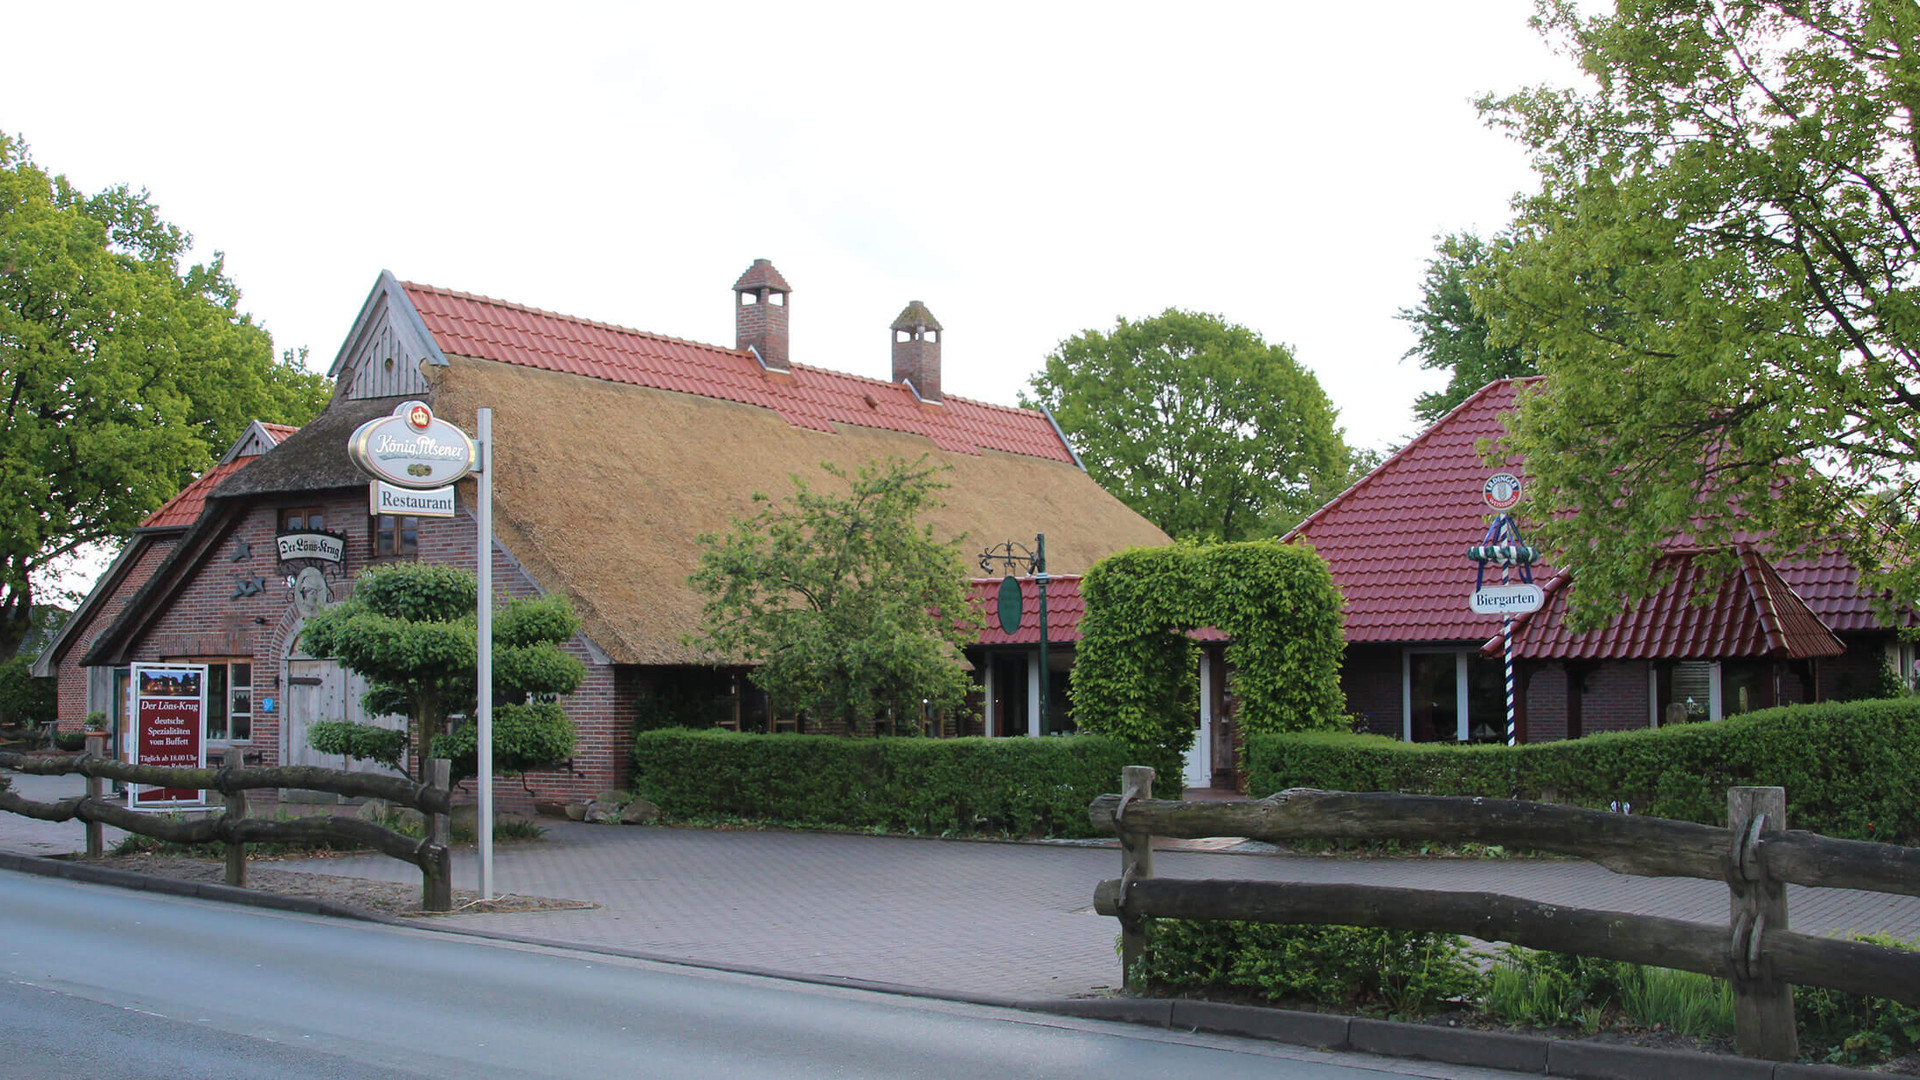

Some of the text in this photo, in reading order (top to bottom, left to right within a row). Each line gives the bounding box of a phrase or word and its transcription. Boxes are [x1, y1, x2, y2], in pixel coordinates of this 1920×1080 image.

[416, 435, 464, 459] Pilsener
[382, 491, 452, 510] Restaurant
[280, 538, 340, 559] Der Löns-Krug
[1476, 594, 1535, 608] Biergarten
[141, 701, 198, 712] Der Löns-Krug
[154, 716, 184, 725] deutsche
[148, 726, 190, 736] Spezialitäten
